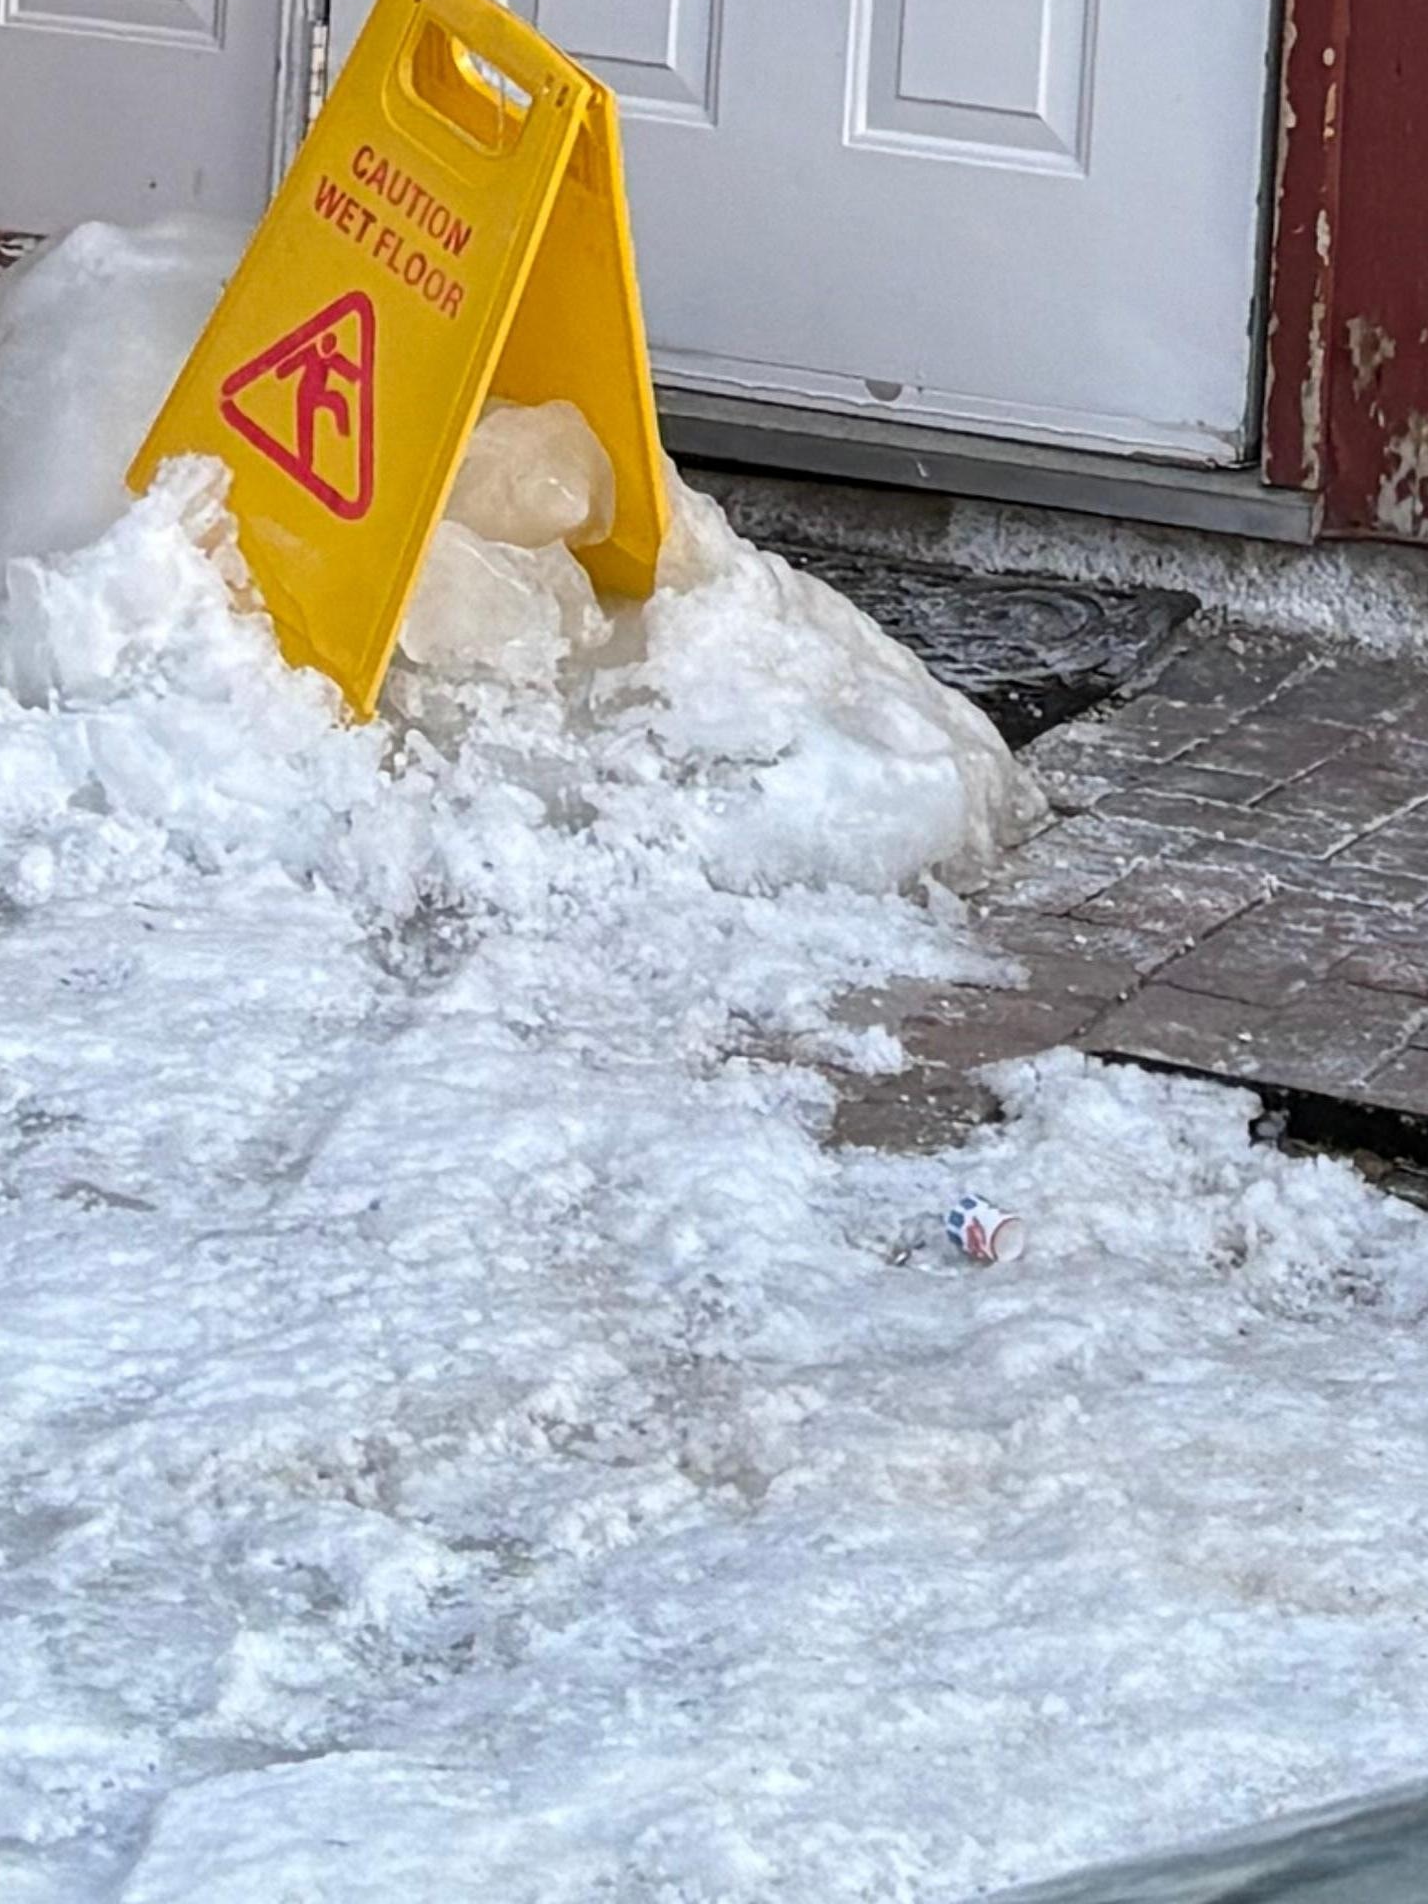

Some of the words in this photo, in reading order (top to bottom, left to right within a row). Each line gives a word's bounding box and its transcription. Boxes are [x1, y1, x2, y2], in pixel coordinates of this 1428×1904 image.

[314, 174, 378, 244] WET
[373, 226, 465, 321] FLOOR
[352, 144, 473, 258] CAUTION
